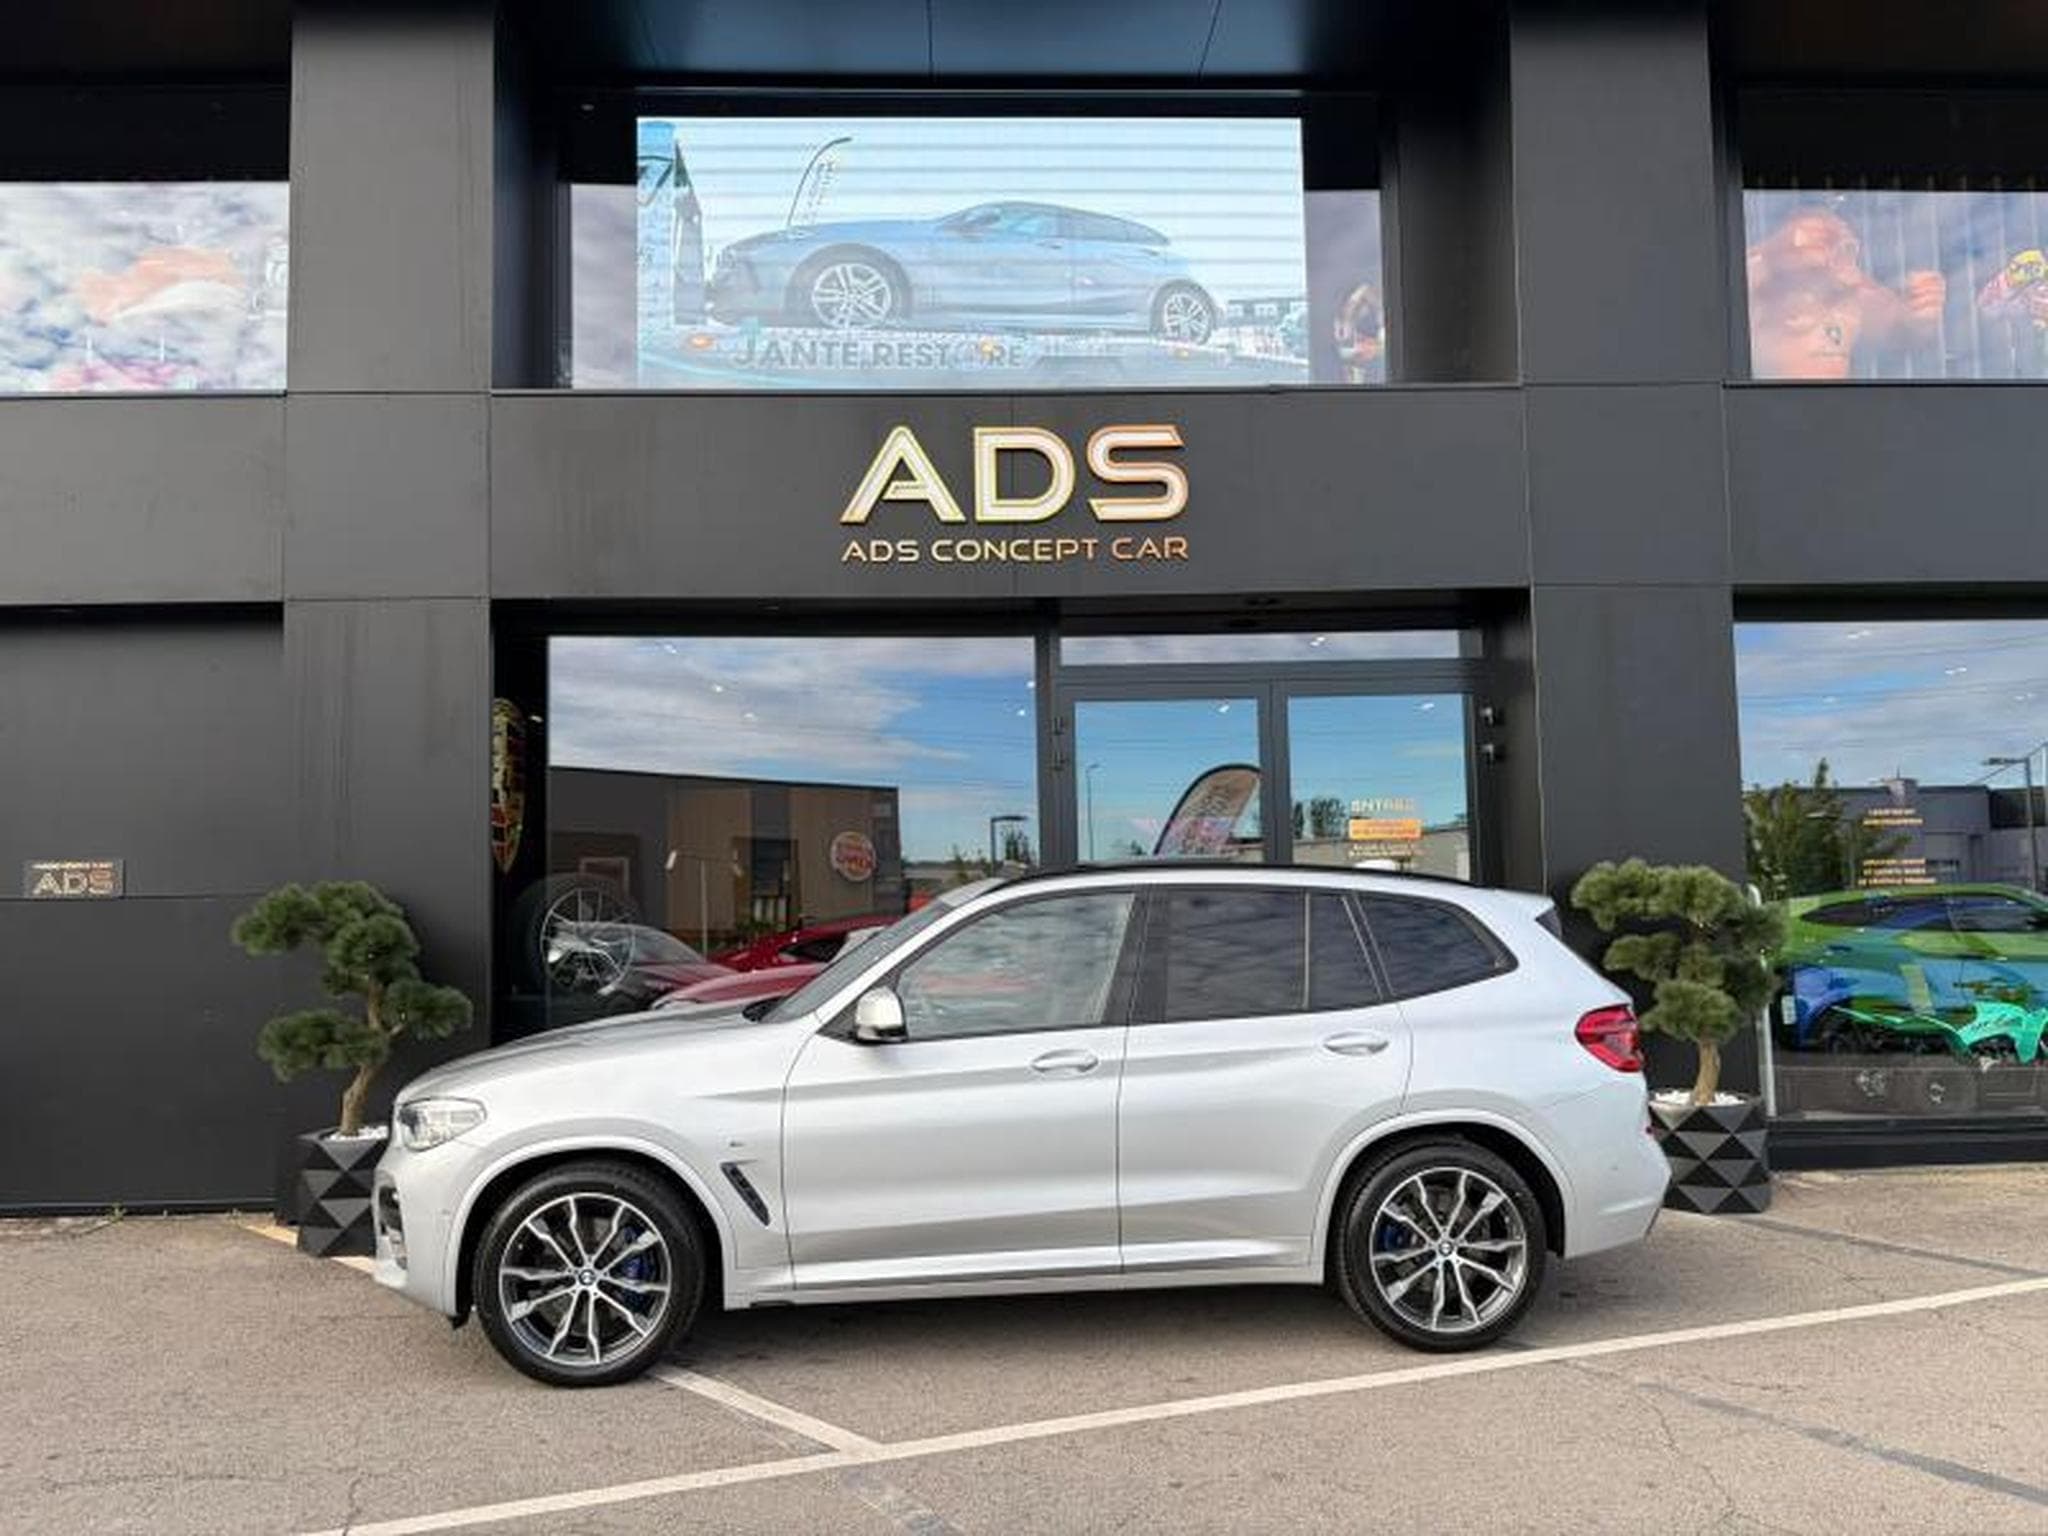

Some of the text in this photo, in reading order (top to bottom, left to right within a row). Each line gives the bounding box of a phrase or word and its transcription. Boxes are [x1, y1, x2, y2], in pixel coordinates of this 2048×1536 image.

[839, 424, 1190, 523] ADS
[842, 537, 1190, 562] ADS CONCEPT CAR
[32, 872, 114, 895] ADS
